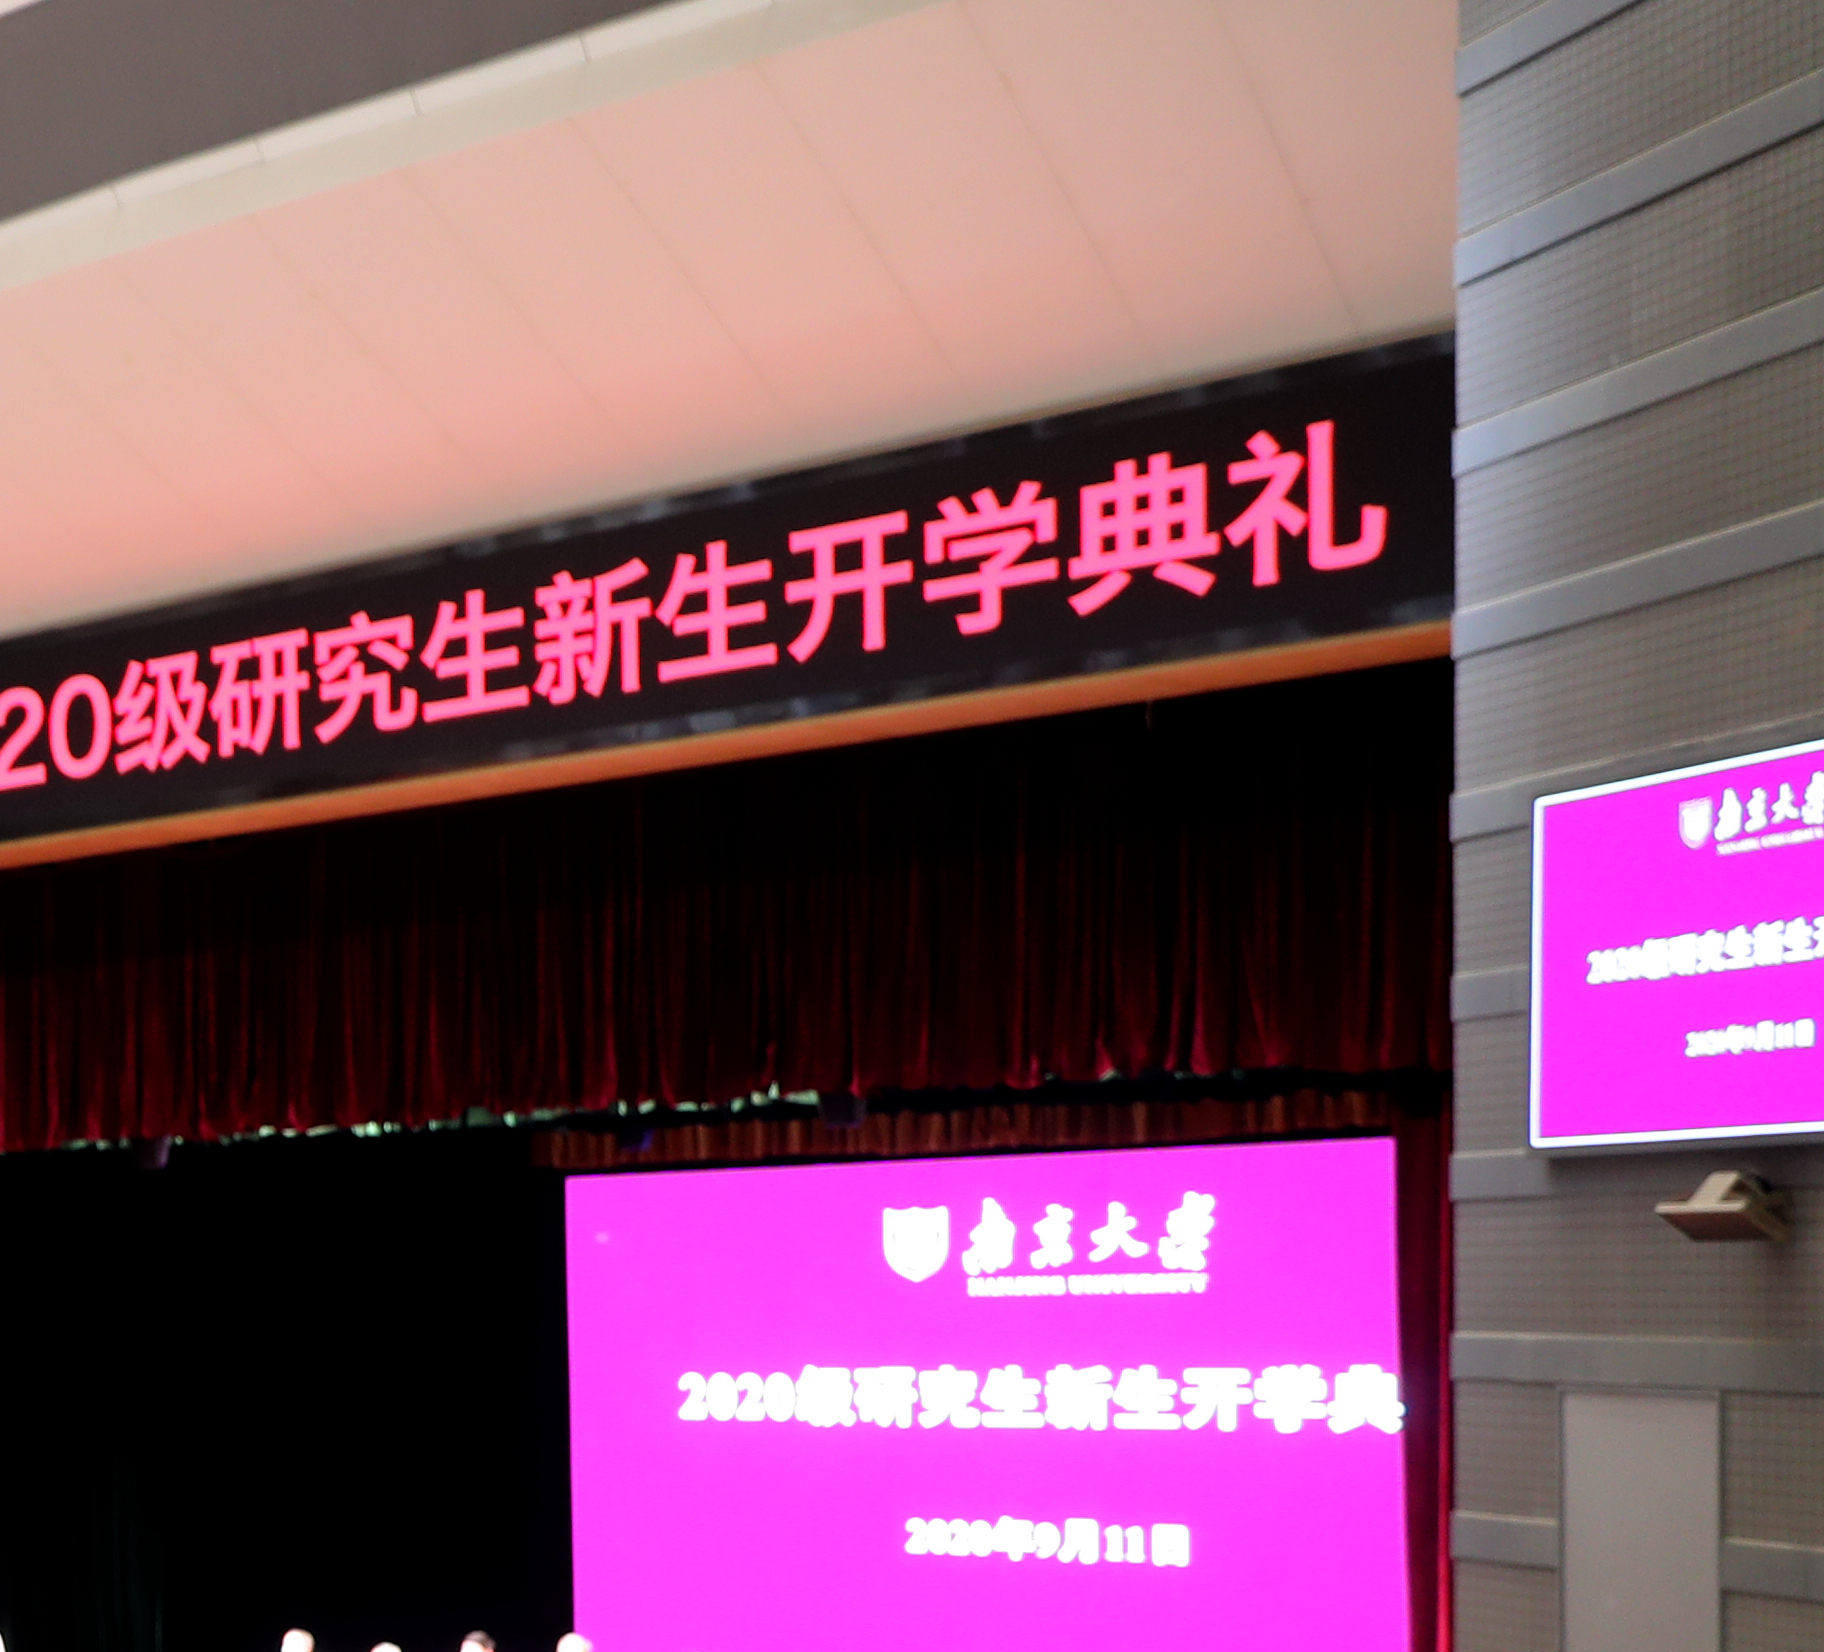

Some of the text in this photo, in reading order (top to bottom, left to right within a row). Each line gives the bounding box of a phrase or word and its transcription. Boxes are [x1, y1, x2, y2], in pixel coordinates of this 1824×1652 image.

[677, 1363, 1405, 1434] 2020级研究生新生开学典
[903, 1514, 1190, 1567] 2020年9月11日
